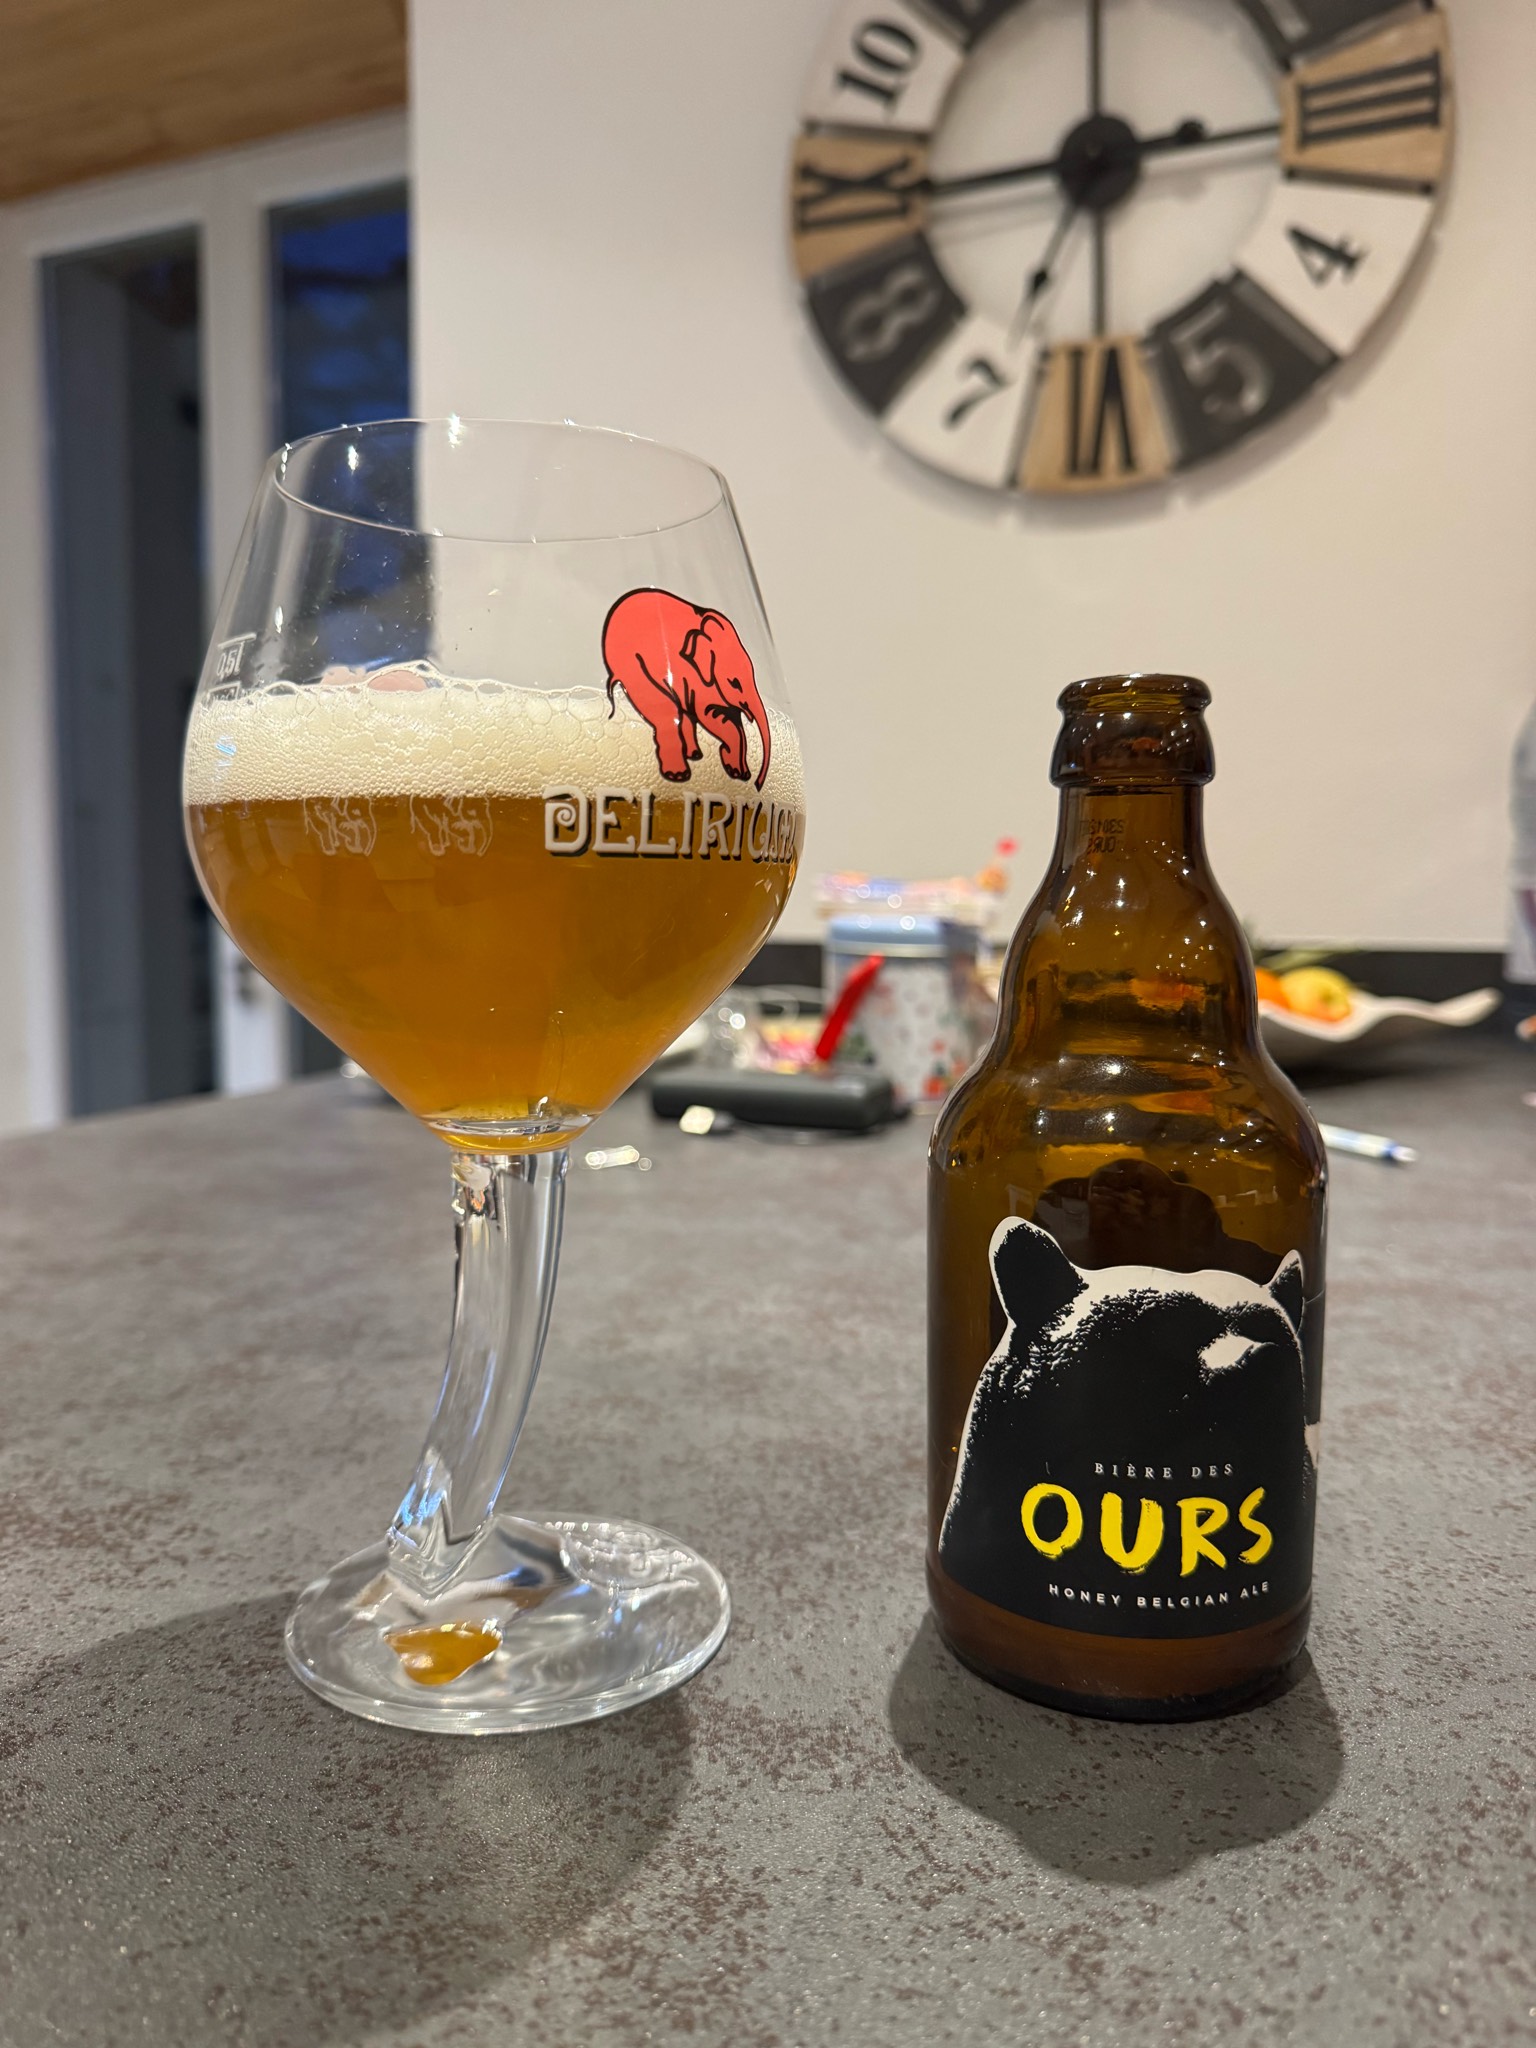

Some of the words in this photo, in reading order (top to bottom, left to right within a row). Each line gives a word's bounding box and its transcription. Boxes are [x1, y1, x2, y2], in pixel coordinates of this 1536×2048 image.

[837, 18, 918, 119] 10
[1297, 50, 1438, 150] III
[799, 156, 919, 232] IX
[1286, 222, 1367, 287] 4
[838, 264, 938, 365] 8
[942, 354, 1013, 431] 7
[1168, 303, 1272, 420] 5
[1065, 343, 1139, 477] VI
[543, 785, 796, 864] DELIRIUM
[1095, 1462, 1172, 1479] BIÈRE
[1192, 1464, 1233, 1478] DES
[1021, 1483, 1272, 1577] OURS
[1049, 1583, 1121, 1605] HONEY
[1137, 1591, 1229, 1607] BELGIAN
[1240, 1580, 1270, 1599] ALE
